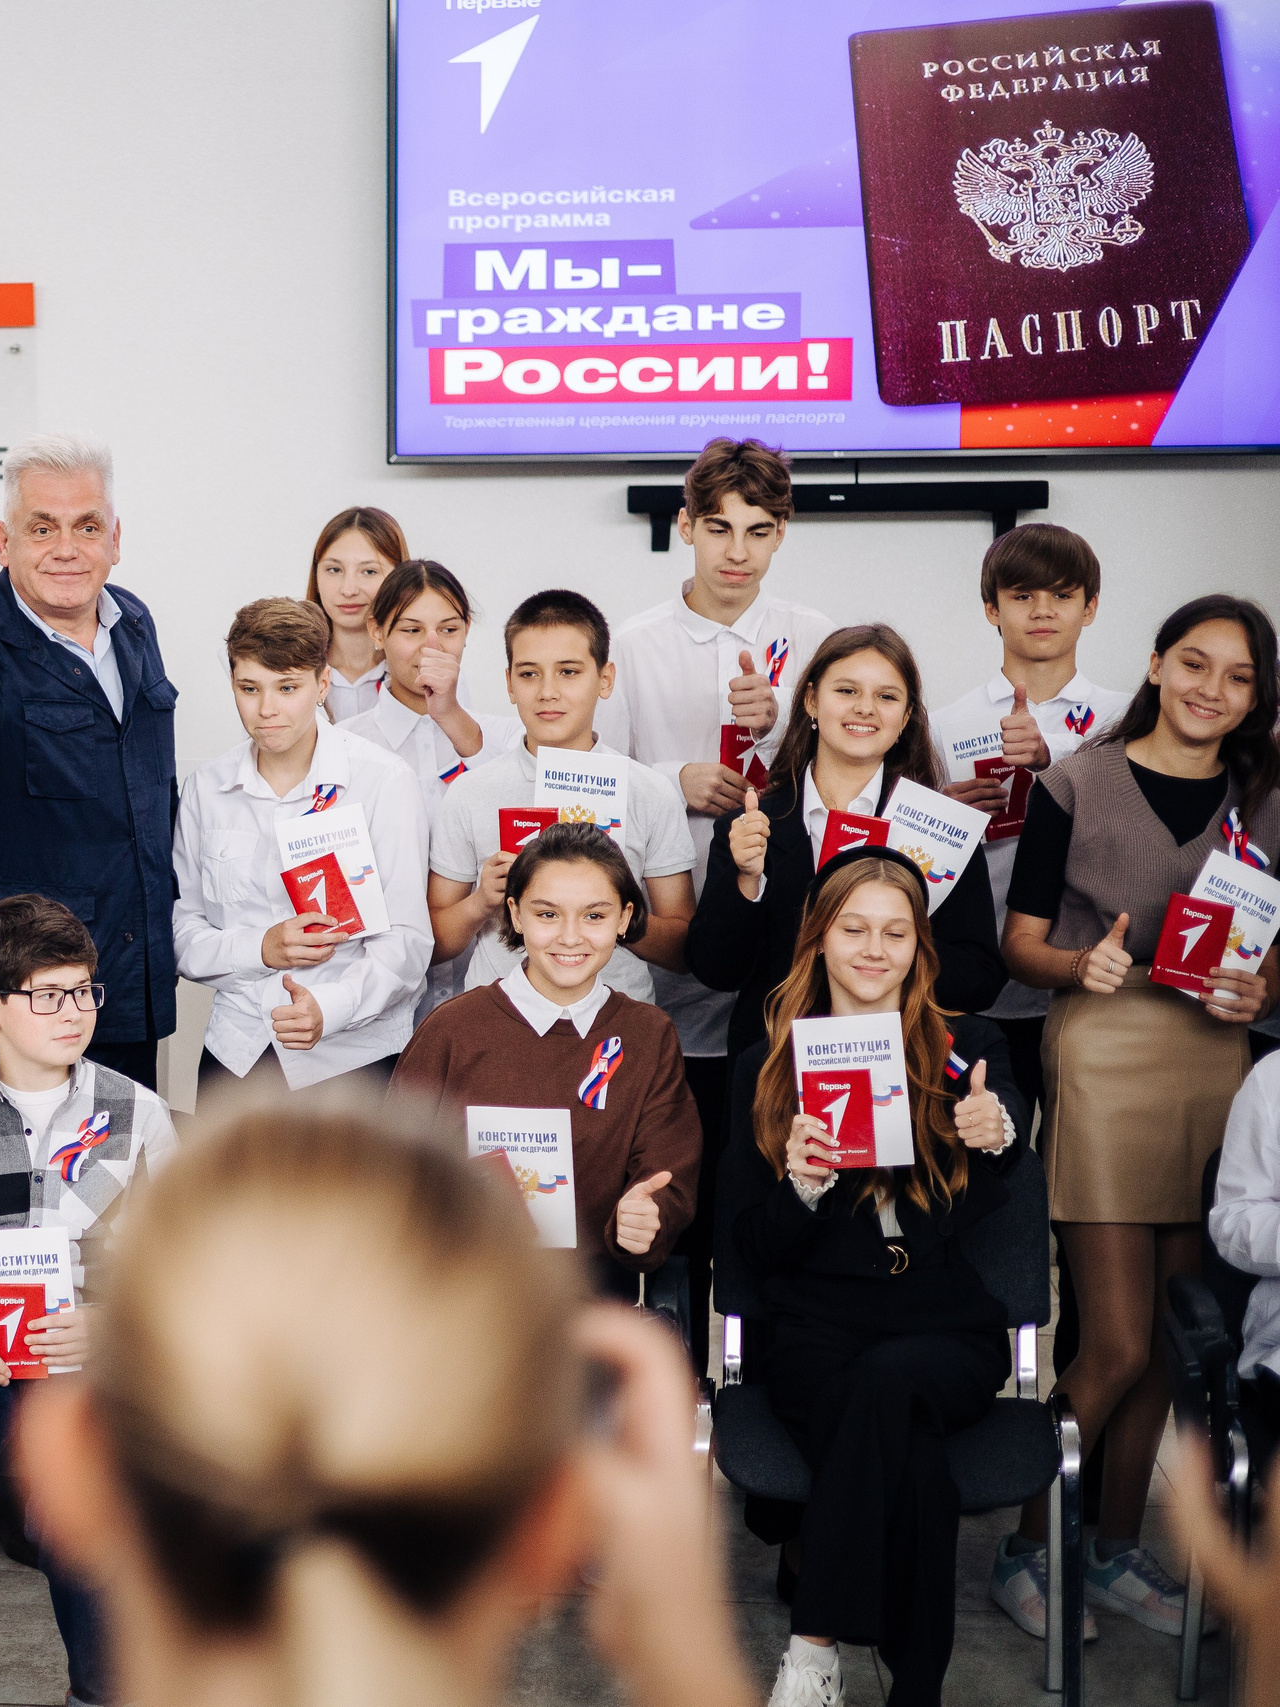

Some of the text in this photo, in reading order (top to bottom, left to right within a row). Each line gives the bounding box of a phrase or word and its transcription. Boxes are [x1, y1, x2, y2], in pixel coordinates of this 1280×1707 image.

[922, 39, 1162, 79] РОССИЙСКАЯ
[940, 66, 1150, 103] ФЕДЕРАЦИЯ
[448, 185, 676, 210] Всероссийская
[448, 211, 611, 233] программа
[425, 302, 786, 343] граждане
[937, 299, 1202, 363] ПАСПОРТ
[443, 343, 830, 395] России!
[443, 412, 846, 430] Торжественная церемония вручения паспорта
[952, 731, 1003, 752] КОНСТИТУ
[955, 747, 989, 760] РОССИЙСКОЙ
[545, 769, 617, 788] КОНСТИТУЦИЯ
[990, 765, 1016, 774] Первые
[544, 782, 616, 797] РОССИЙСКОЙ ФЕДЕРАЦИИ
[513, 819, 541, 828] Первые
[840, 823, 870, 836] Первые
[896, 802, 969, 841] КОНСТИТУЦИЯ
[288, 827, 358, 852] КОНСТИТУЦИЯ
[892, 814, 964, 850] РОССИЙСКОЙ ФЕДЕРАЦИИ
[297, 868, 324, 884] Первые
[1208, 874, 1278, 917] КОНСТИТУЦИЯ
[1182, 907, 1213, 921] Первые
[807, 1039, 891, 1056] КОНСТИТУЦИЯ
[808, 1053, 892, 1067] РОССИЙСКОЙ ФЕДЕРАЦИИ
[818, 1082, 852, 1093] Первые
[477, 1131, 558, 1145] КОНСТИТУЦИЯ
[520, 1145, 559, 1154] ФЕДЕРАЦИИ
[22, 1267, 60, 1276] ФЕДЕРАЦИИ
